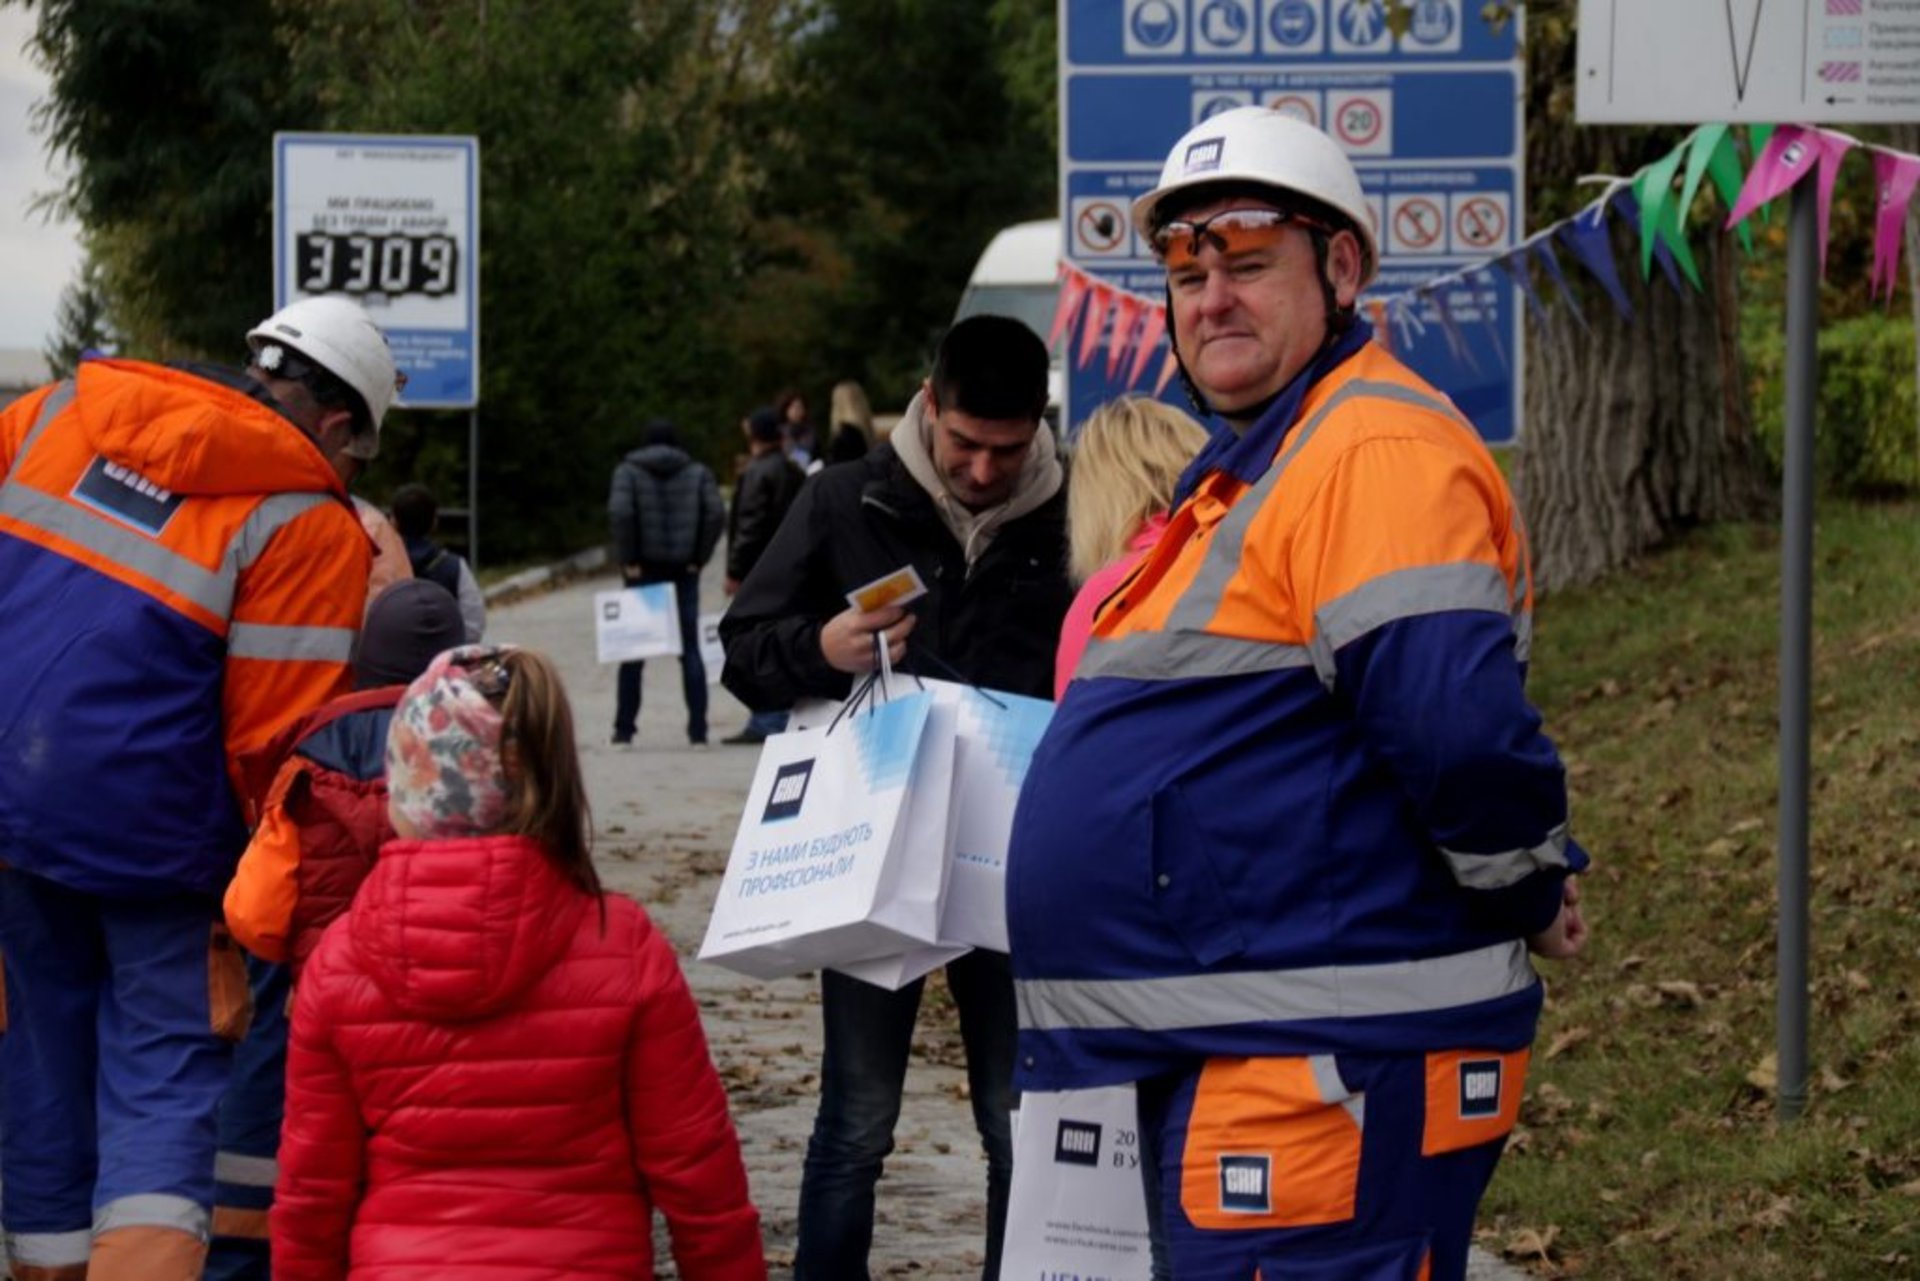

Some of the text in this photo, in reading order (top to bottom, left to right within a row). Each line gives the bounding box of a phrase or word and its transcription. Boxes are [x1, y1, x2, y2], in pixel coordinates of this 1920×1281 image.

[1346, 110, 1373, 131] 20
[304, 236, 453, 292] 3309
[745, 822, 873, 872] З НАМИ БУДУЮТЬ
[738, 855, 856, 898] ПРОФЕСІОНАЛИ
[1465, 1072, 1497, 1100] CRH
[1061, 1128, 1096, 1155] CRH
[1226, 1166, 1263, 1195] CRH
